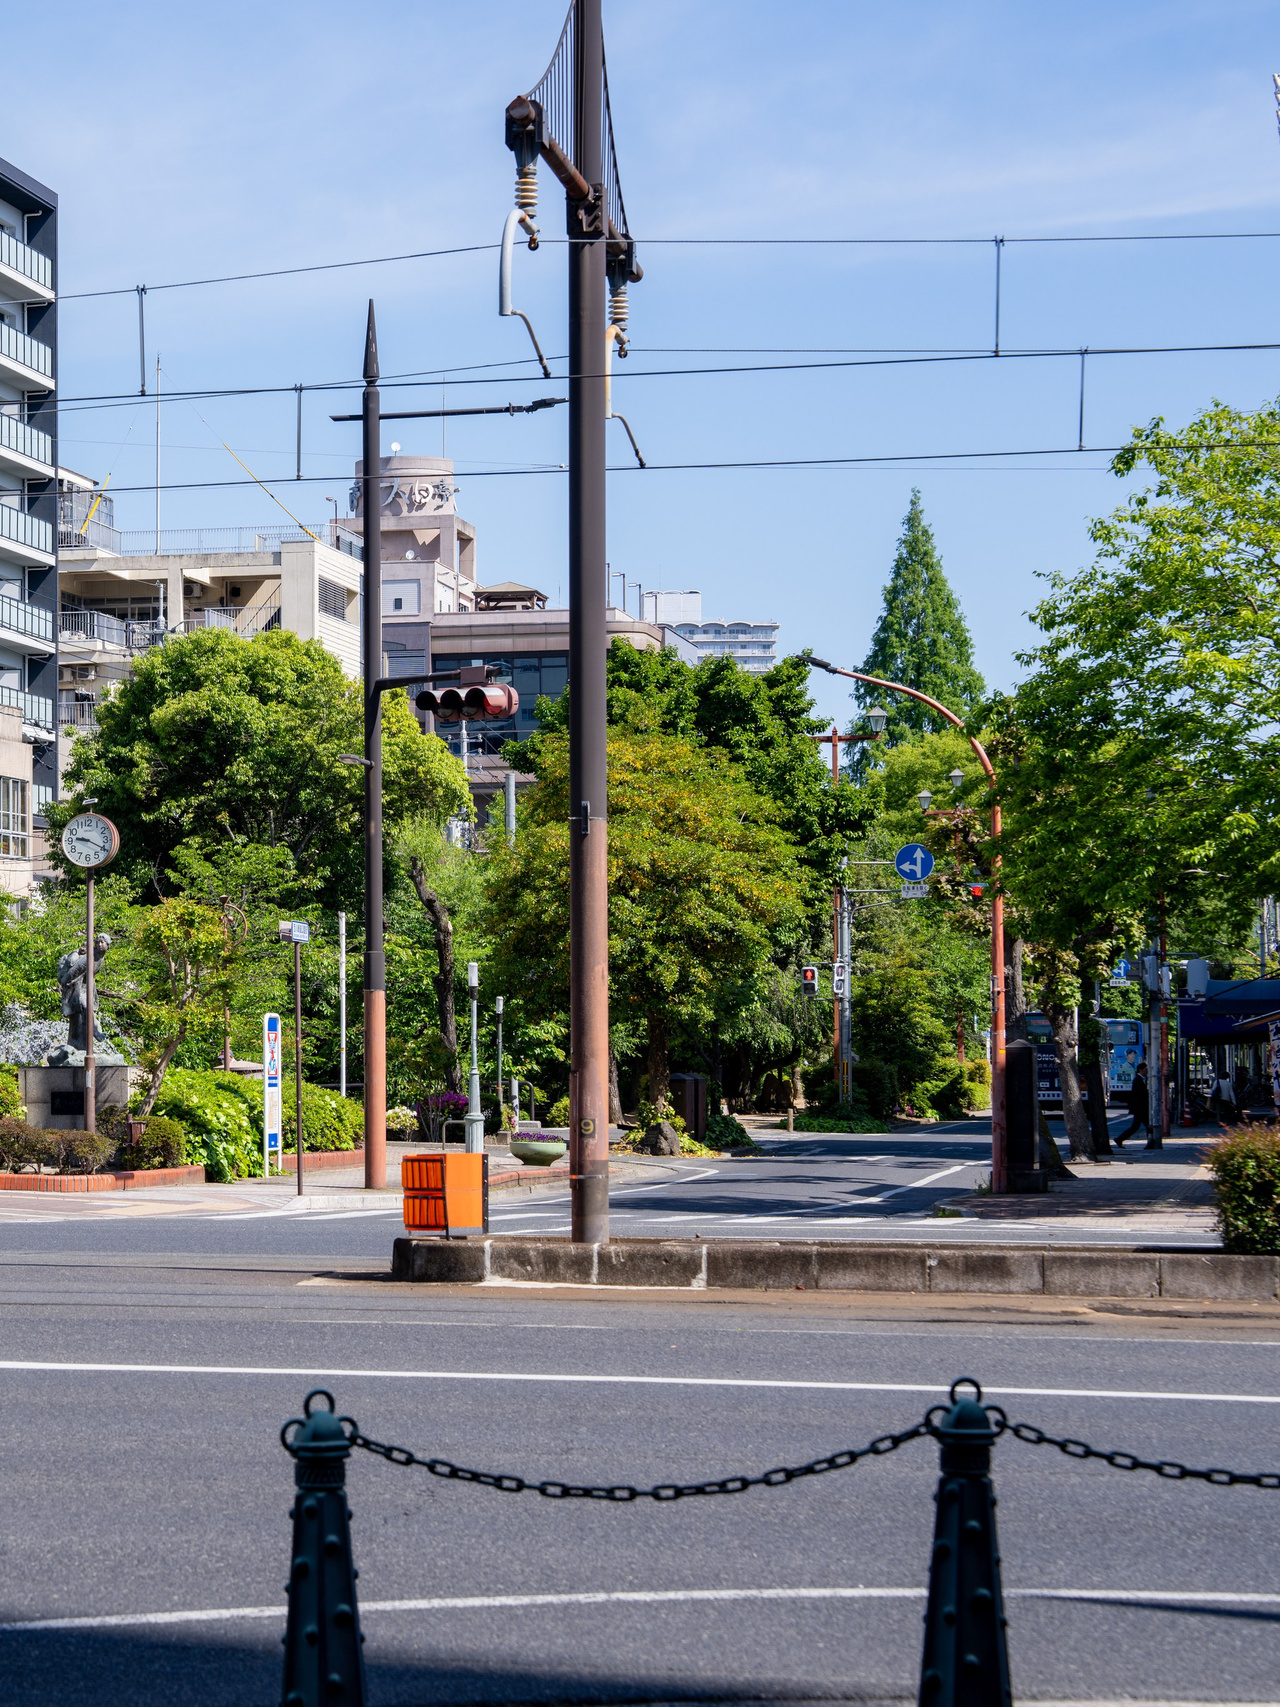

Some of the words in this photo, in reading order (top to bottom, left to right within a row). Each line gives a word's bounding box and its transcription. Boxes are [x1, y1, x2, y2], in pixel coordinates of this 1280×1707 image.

[76, 820, 83, 829] 11
[84, 819, 93, 827] 12
[68, 828, 77, 836] 10
[100, 827, 106, 835] 2
[67, 837, 73, 845] 9
[70, 845, 76, 853] 8
[77, 852, 83, 860] 7
[85, 854, 91, 862] 6
[94, 851, 100, 859] 5
[581, 1119, 594, 1135] 9
